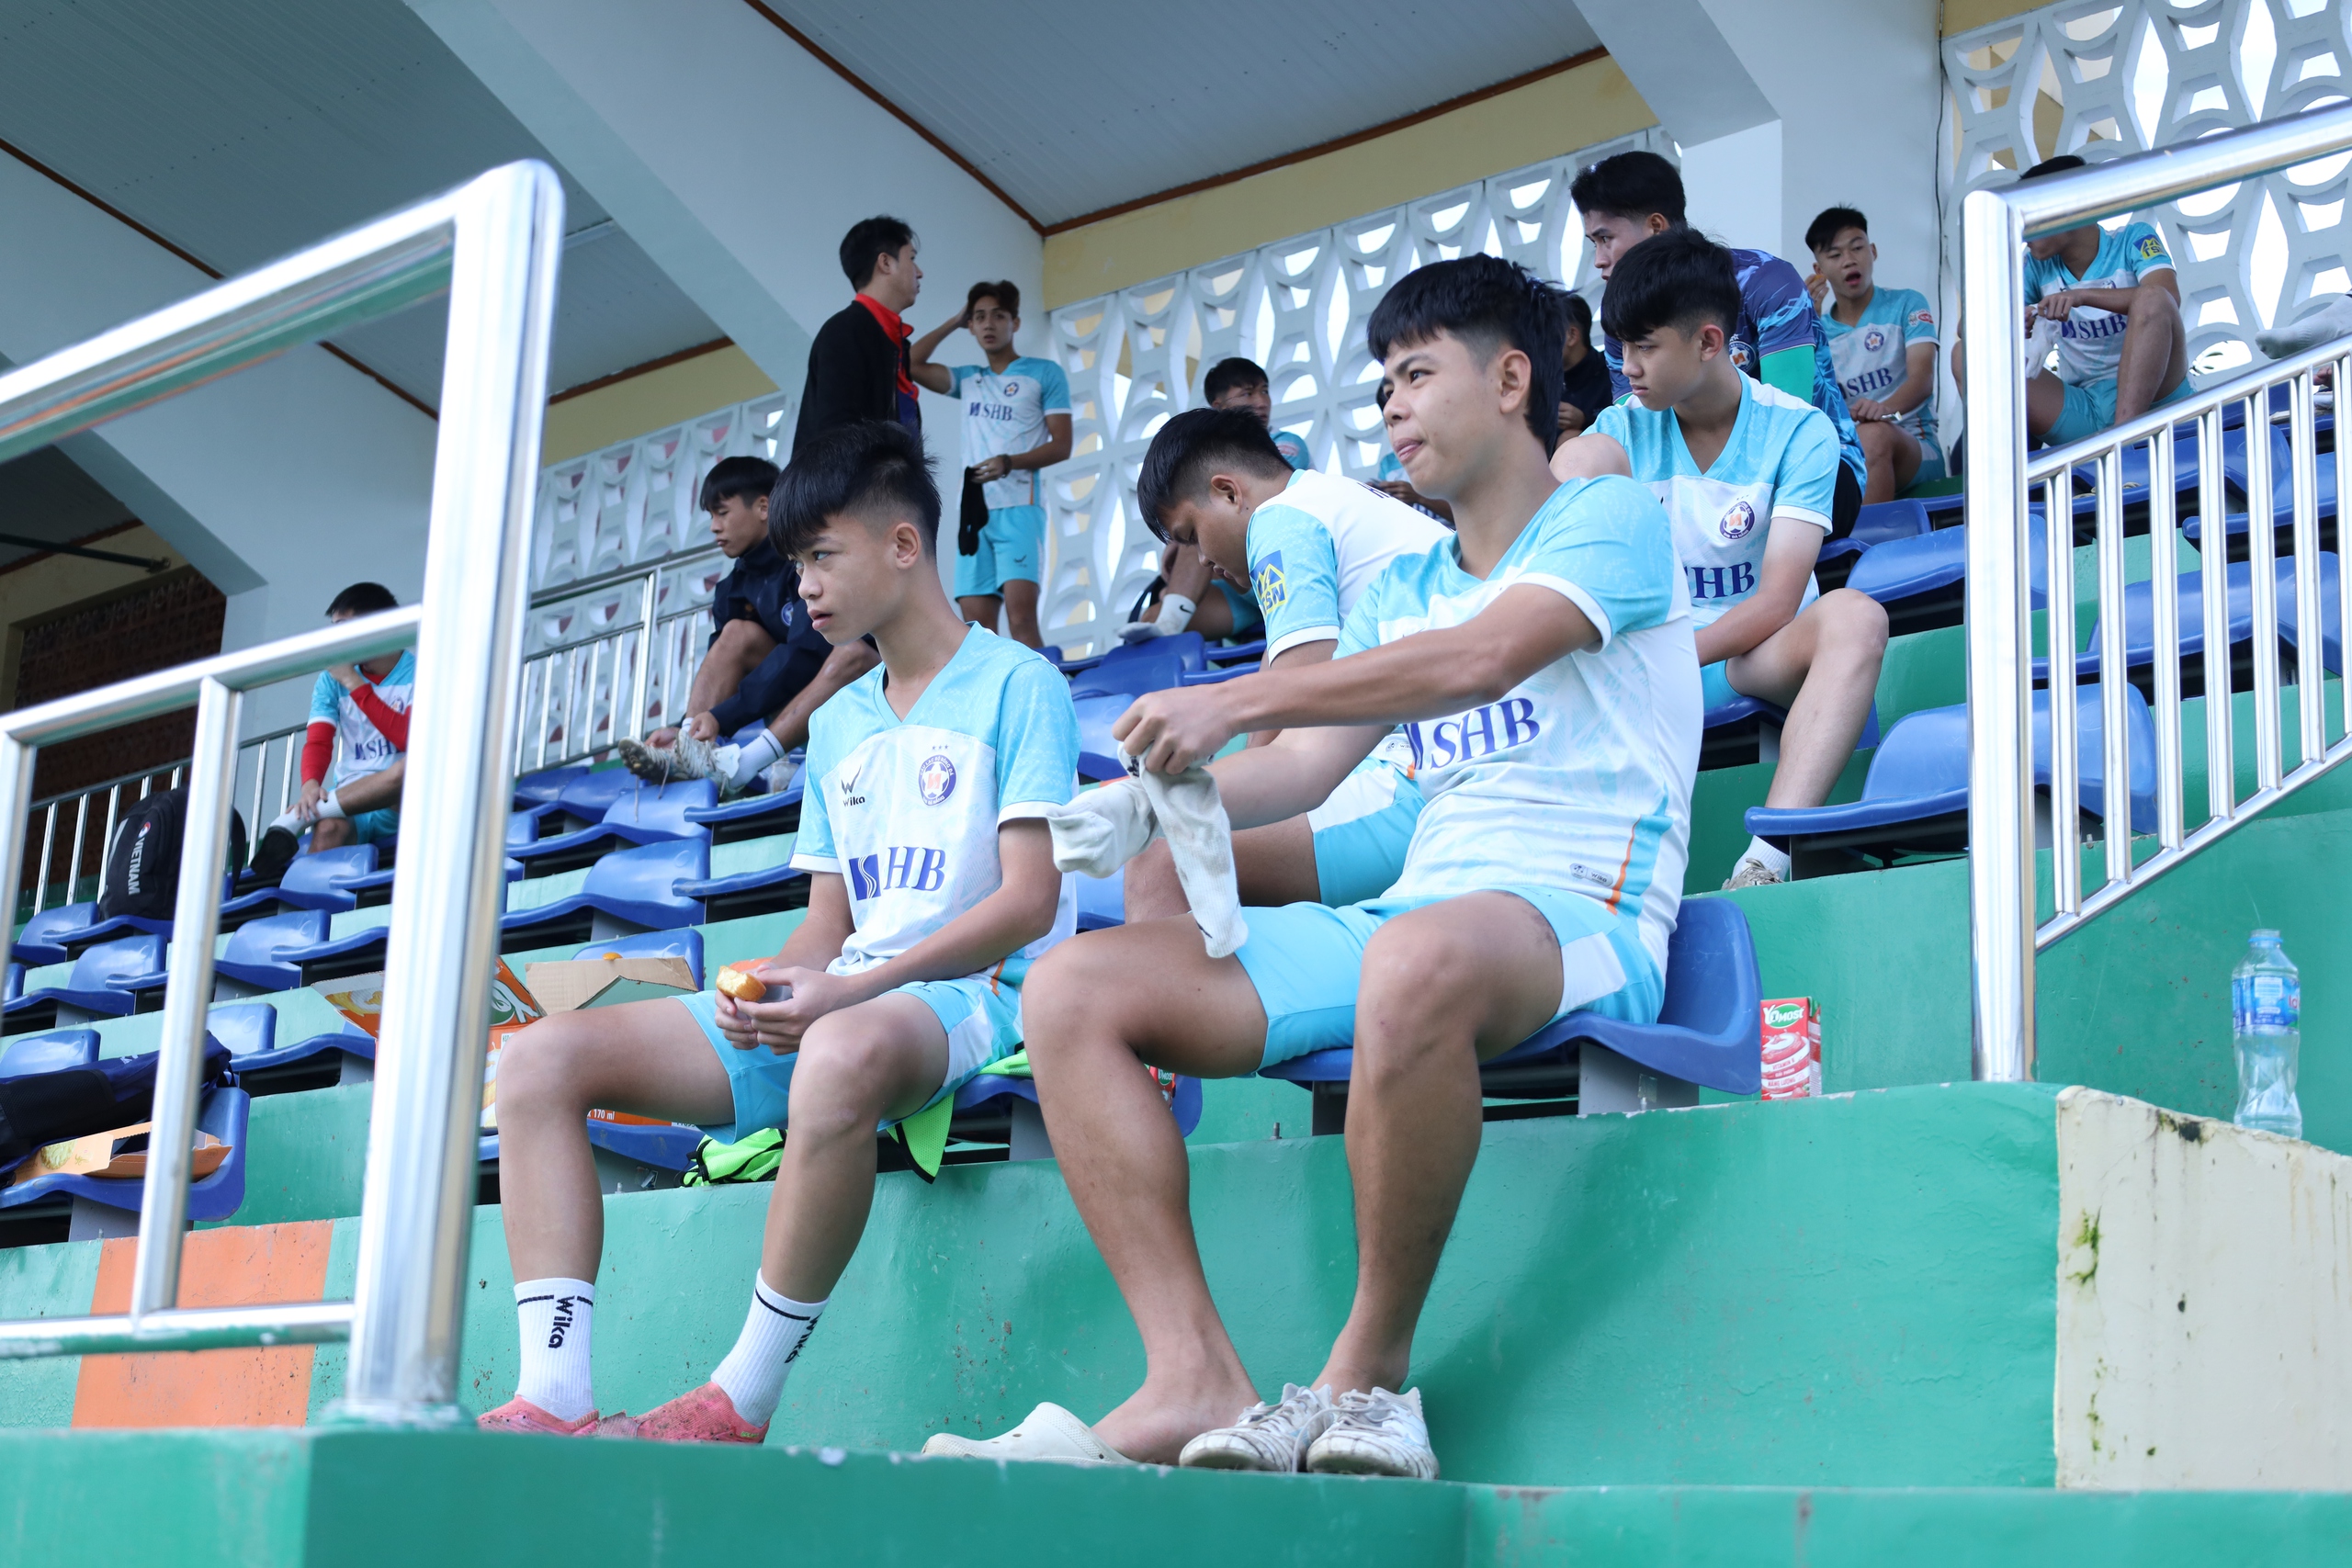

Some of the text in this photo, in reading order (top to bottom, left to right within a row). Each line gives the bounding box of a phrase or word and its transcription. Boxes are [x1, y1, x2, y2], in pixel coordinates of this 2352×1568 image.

[2078, 313, 2127, 339] SHB
[1847, 367, 1893, 397] SHB
[982, 403, 1012, 422] SHB
[1684, 561, 1755, 599] HB
[1430, 697, 1540, 770] SHB
[367, 739, 405, 760] SH
[842, 795, 865, 807] Wika
[128, 837, 145, 896] VIETNAM
[594, 1109, 605, 1119] 170
[606, 1111, 616, 1120] ml
[548, 1295, 575, 1348] Wika
